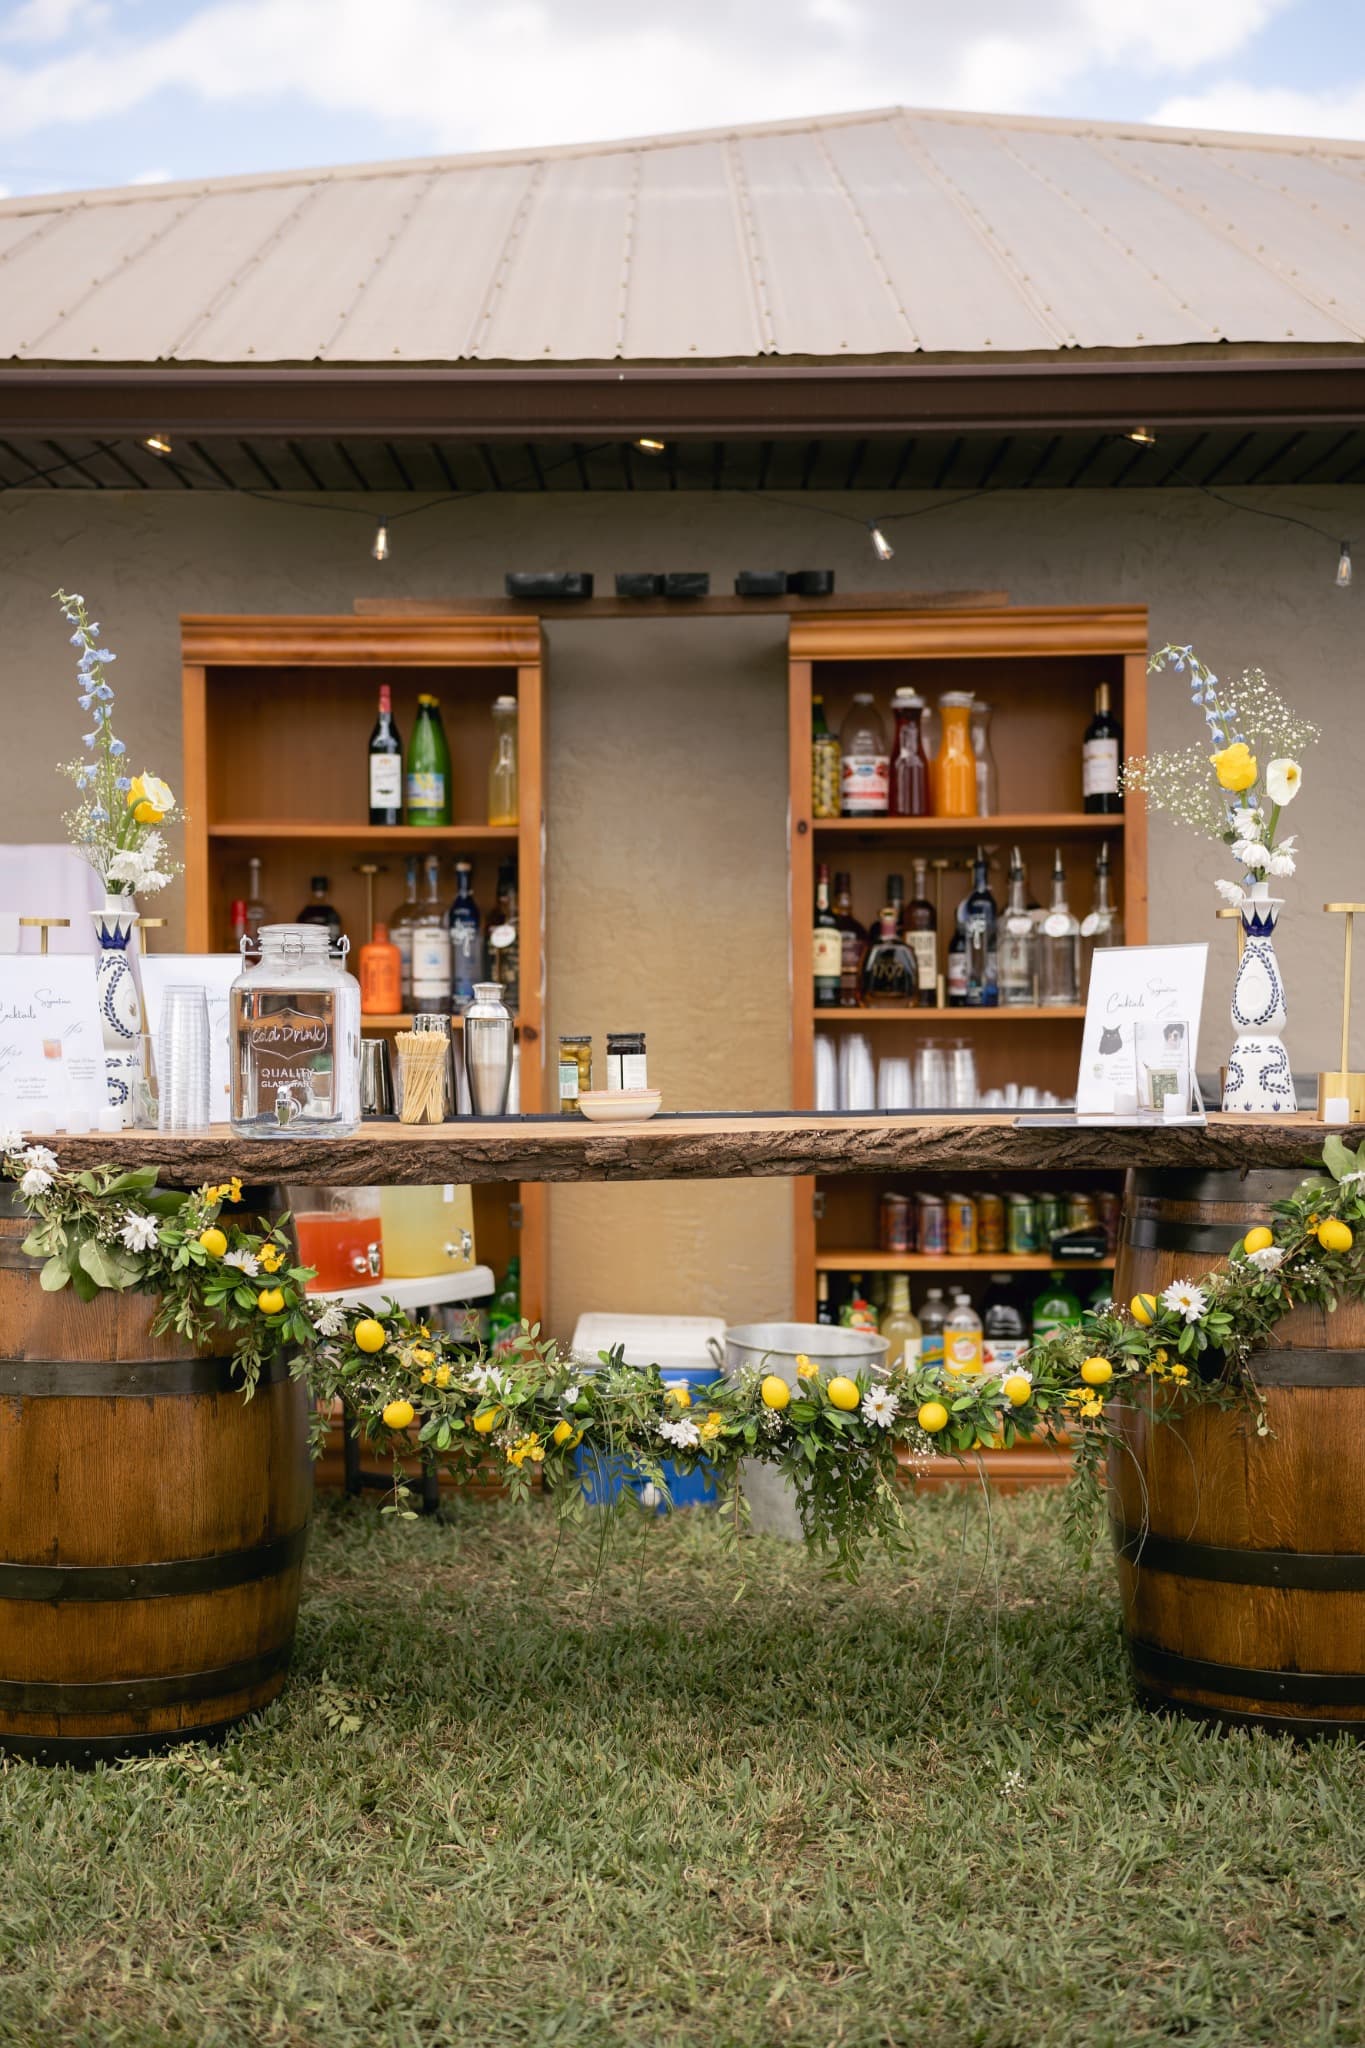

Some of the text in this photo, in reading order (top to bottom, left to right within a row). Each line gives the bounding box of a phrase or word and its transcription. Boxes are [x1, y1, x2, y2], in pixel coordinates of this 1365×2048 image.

[1106, 992, 1145, 1014] Cocktails
[252, 1024, 325, 1044] Cold Drink
[260, 1067, 315, 1079] QUALITY
[260, 1080, 314, 1089] GLASARE
